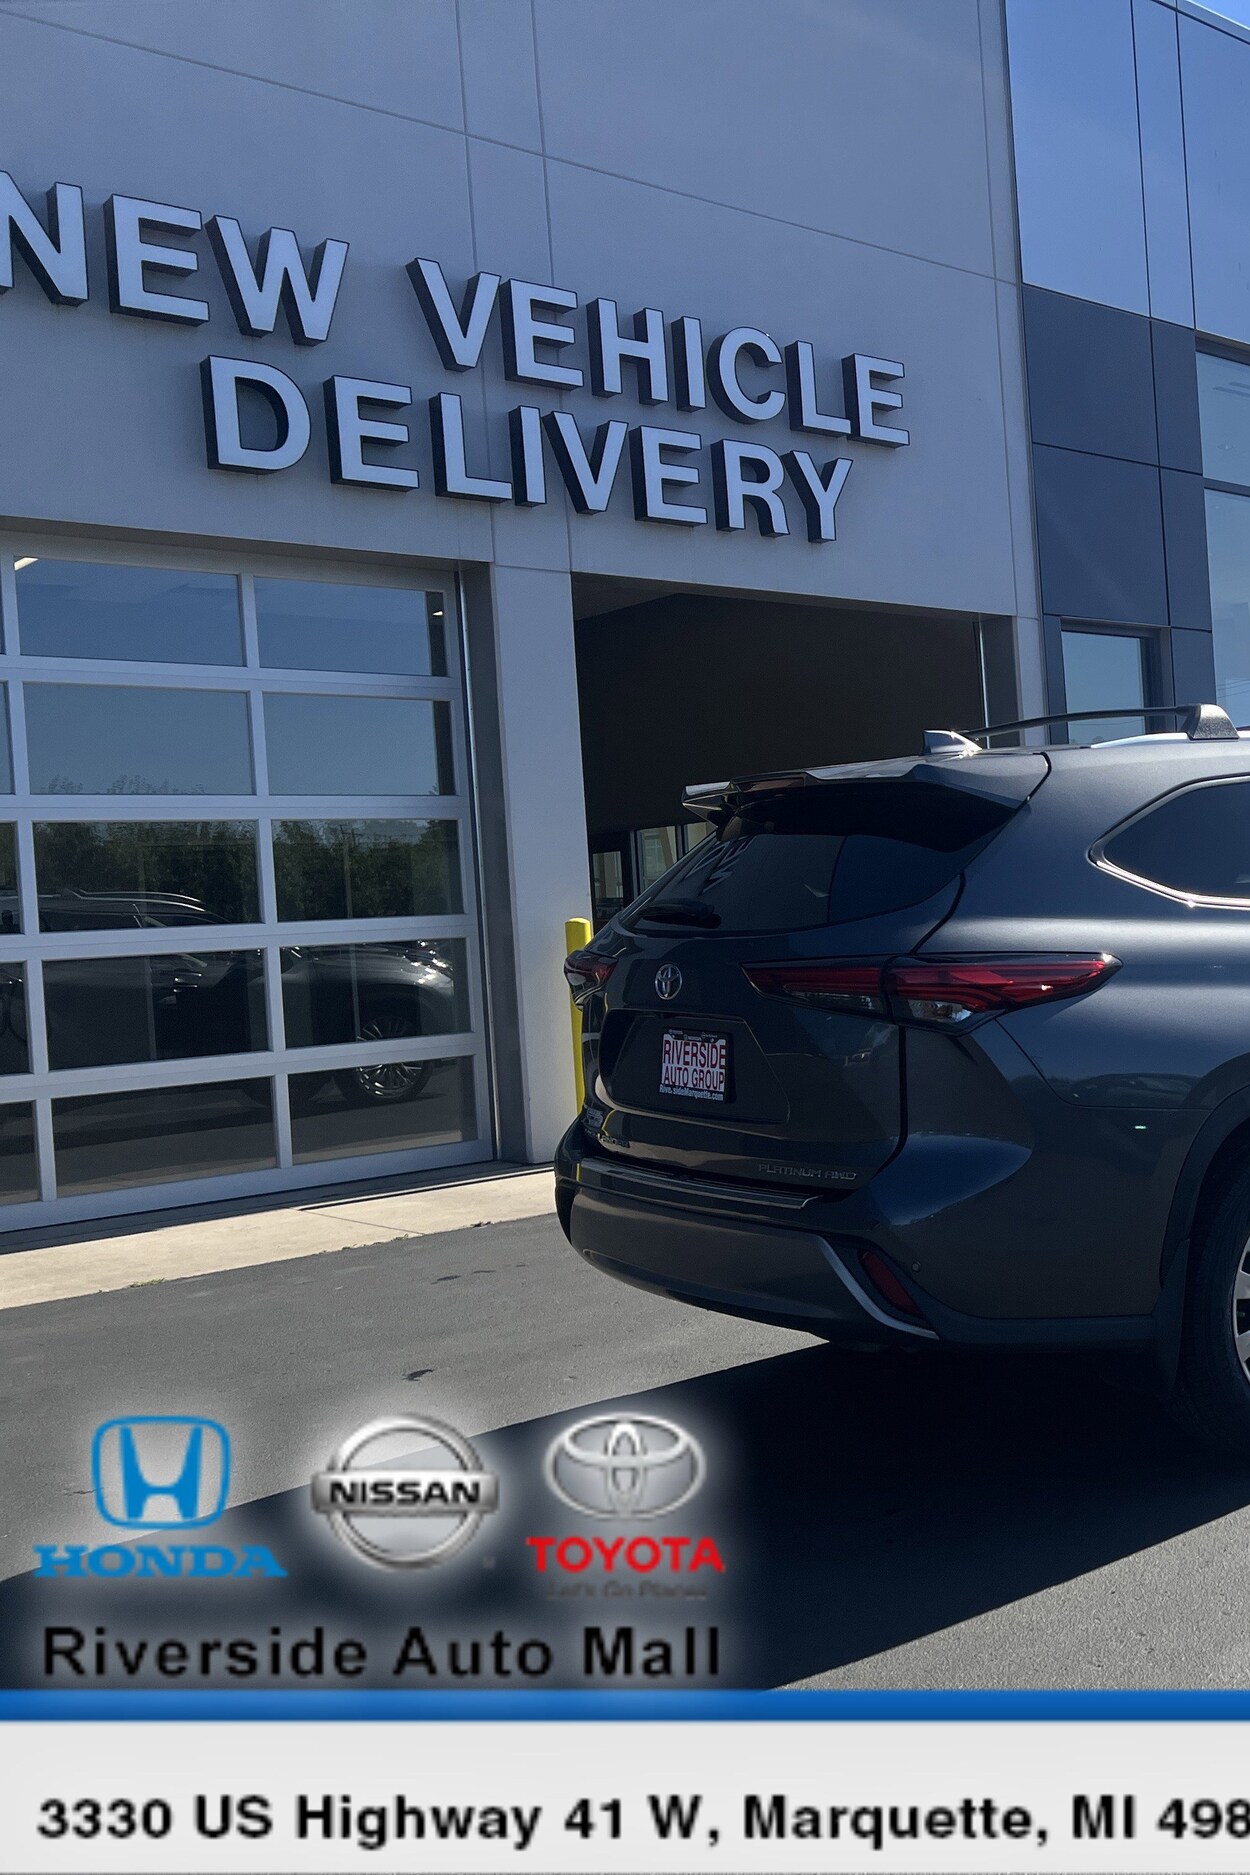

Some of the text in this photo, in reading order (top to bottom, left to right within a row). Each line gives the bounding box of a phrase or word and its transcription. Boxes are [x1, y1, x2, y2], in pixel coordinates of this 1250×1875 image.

[0, 171, 910, 448] NEW VEHICLE
[200, 355, 853, 543] DELIVERY
[663, 1039, 726, 1070] RIVERSIDE
[664, 1065, 725, 1091] AUTO GROUP
[759, 1163, 857, 1180] PLATINUM AWD
